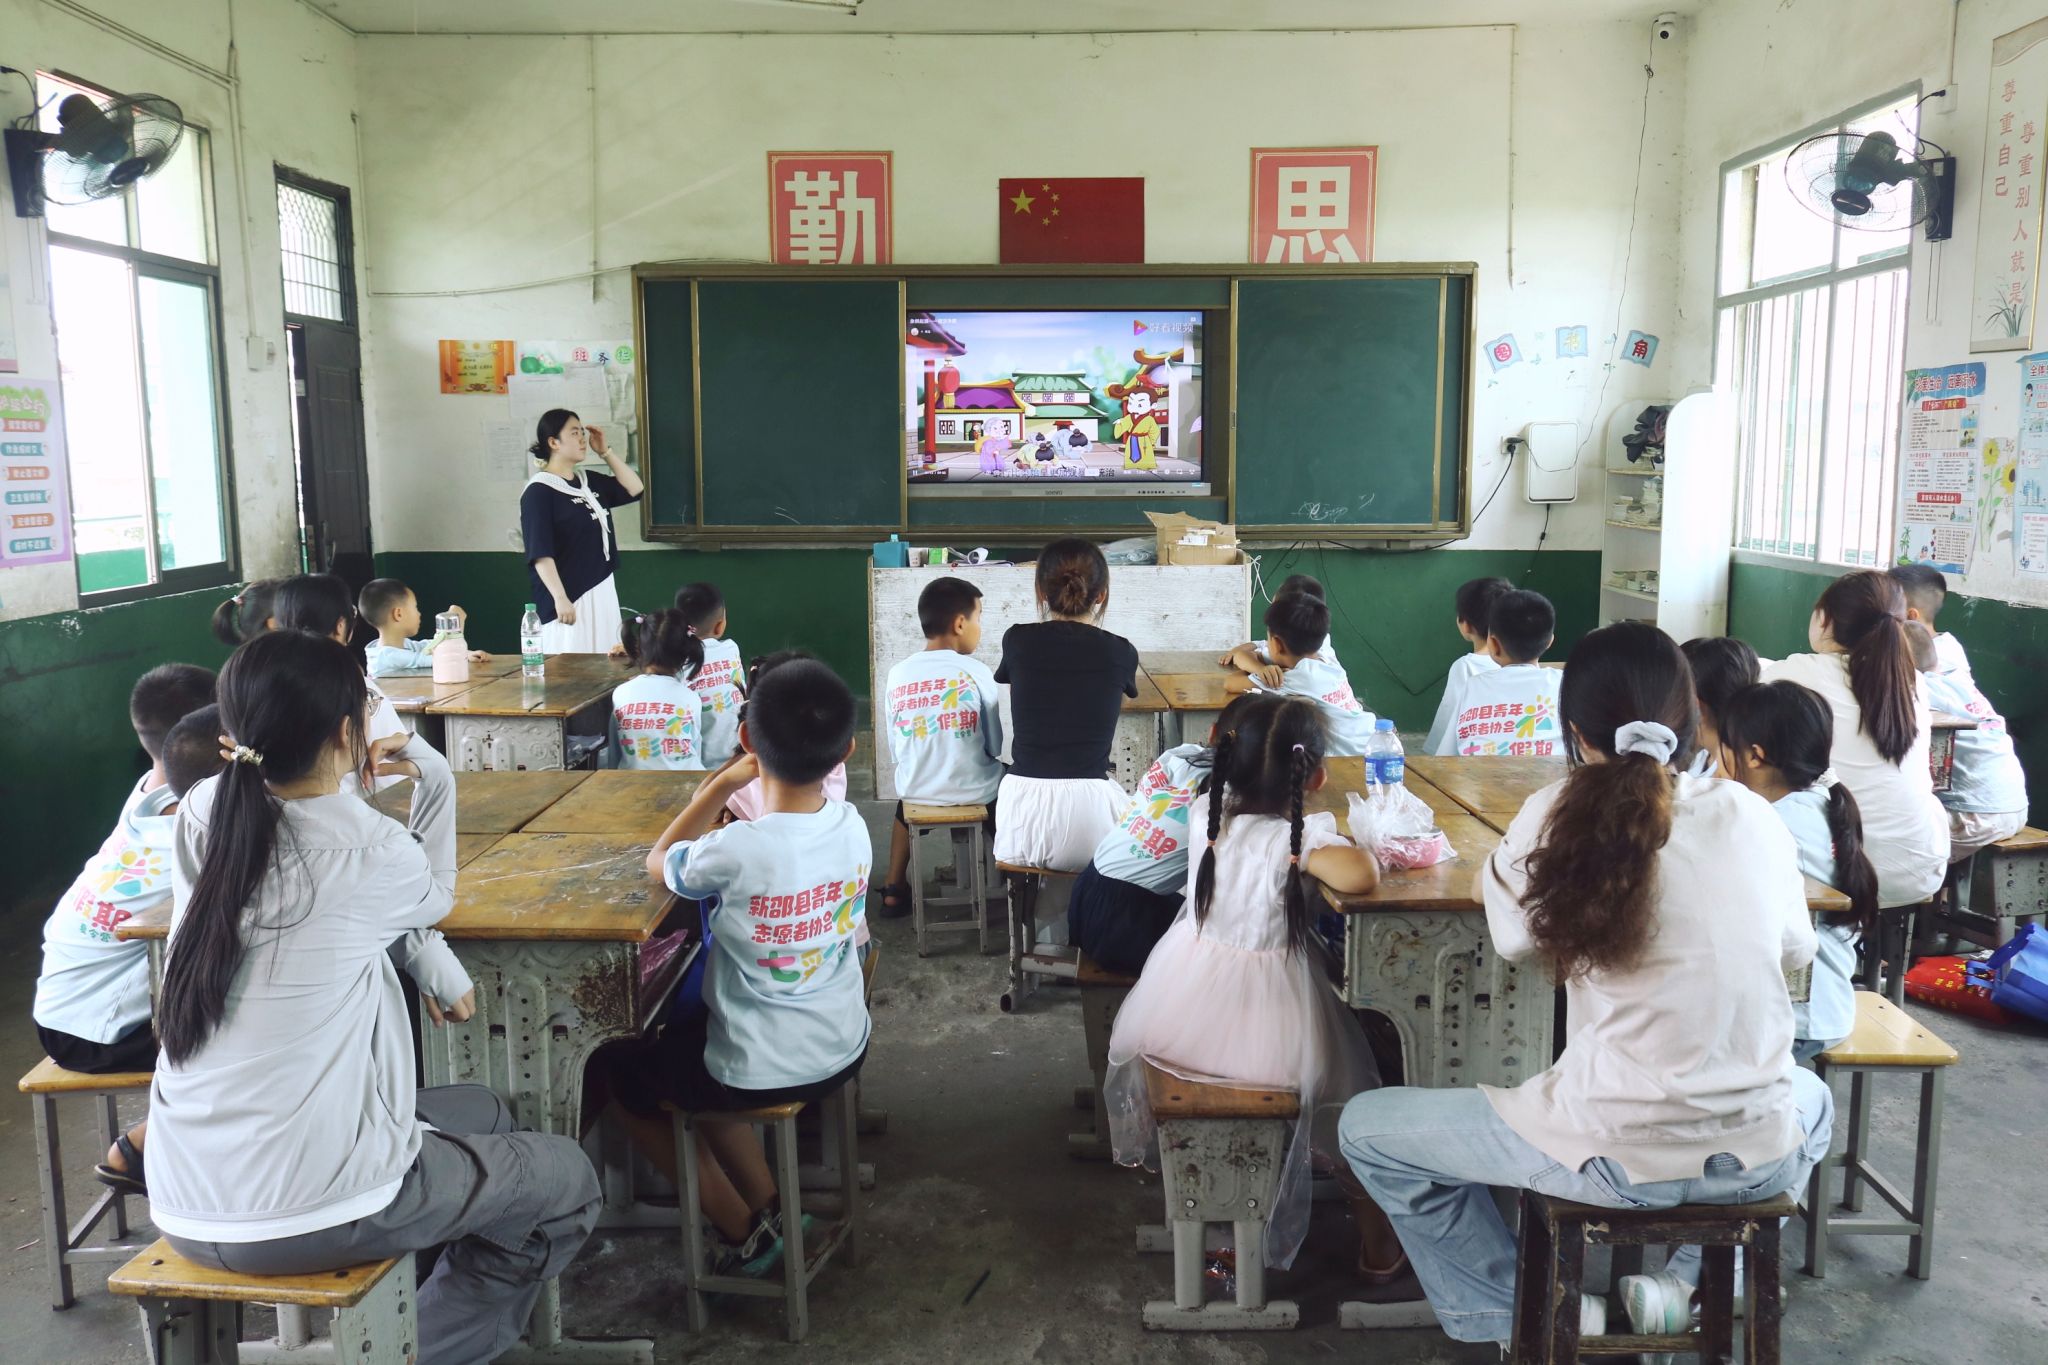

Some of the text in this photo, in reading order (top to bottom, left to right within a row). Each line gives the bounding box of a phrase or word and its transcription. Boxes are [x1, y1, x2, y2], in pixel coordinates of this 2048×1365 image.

[1995, 79, 2017, 197] 尊重自己
[2008, 120, 2036, 304] 尊重别人就是
[1149, 322, 1194, 333] 好看视频
[749, 880, 844, 919] 新邵县青年
[752, 910, 833, 944] 志愿者协会
